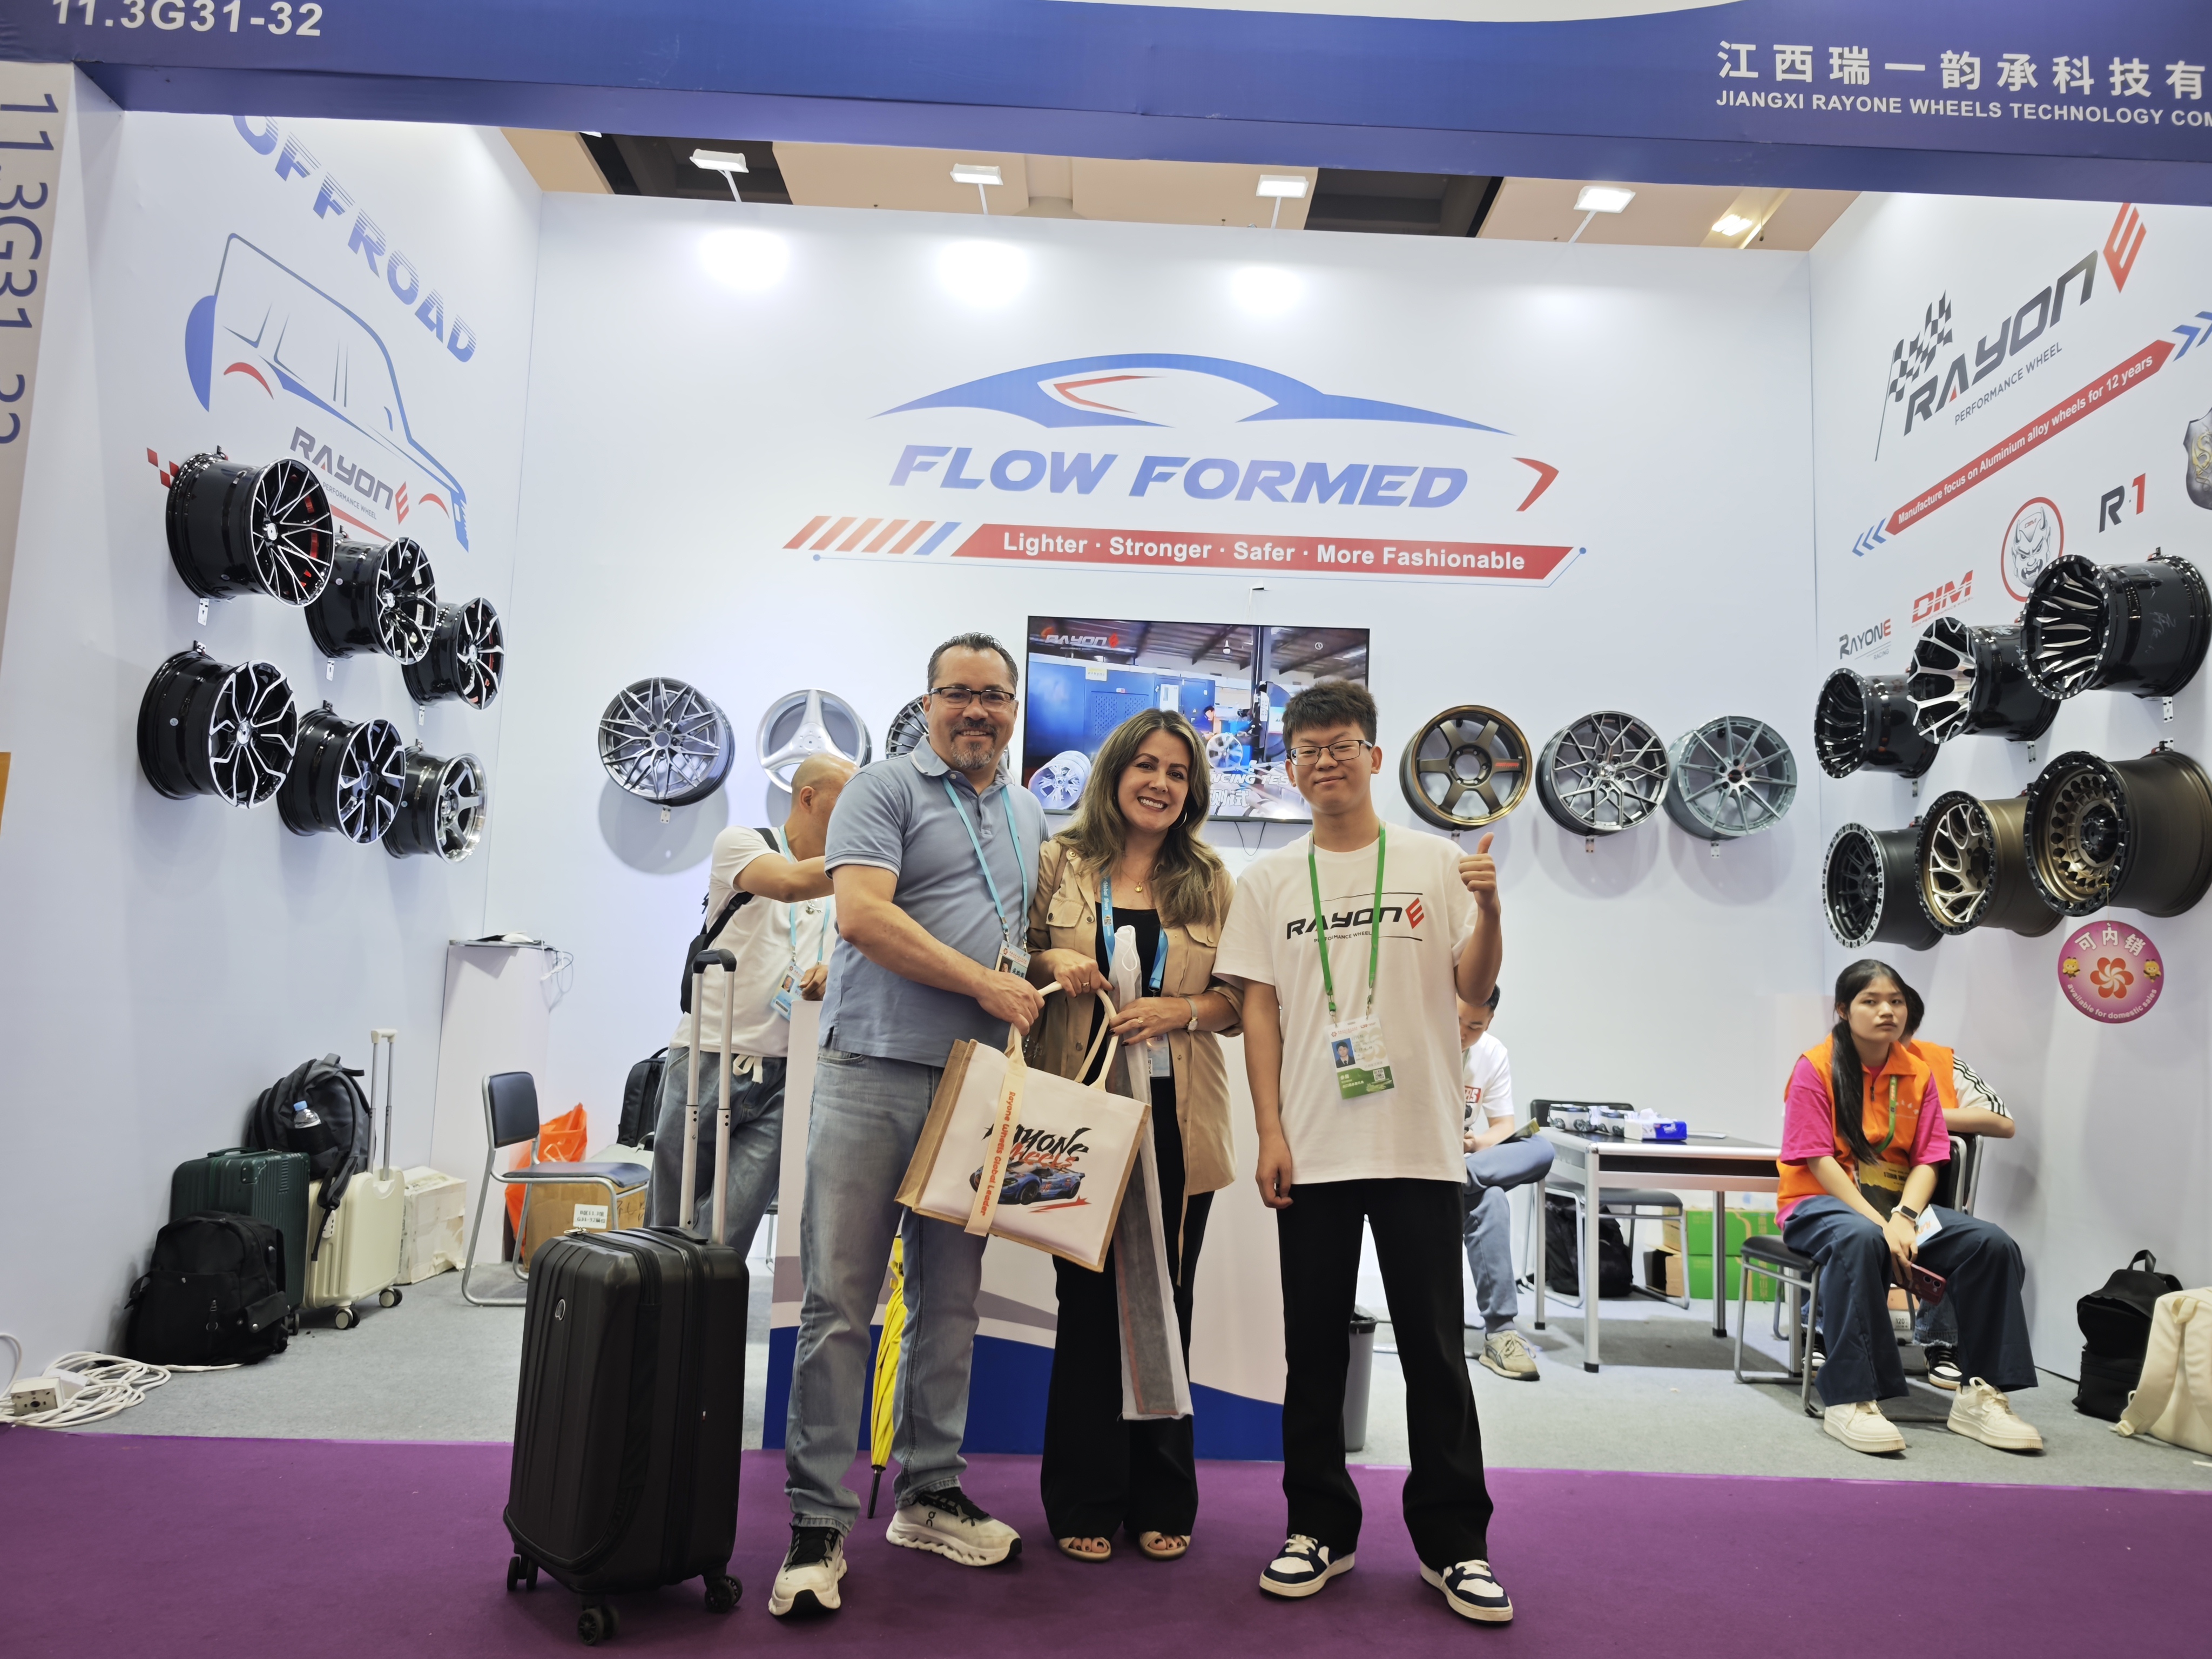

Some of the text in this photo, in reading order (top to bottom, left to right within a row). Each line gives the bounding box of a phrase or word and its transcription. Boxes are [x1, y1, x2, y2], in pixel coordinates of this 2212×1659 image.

[52, 0, 323, 36] 11.3G31-32
[1717, 40, 2206, 100] 江西瑞一韵承科技有
[1716, 91, 1804, 109] JIANGXI
[1812, 94, 1902, 113] RAYONE
[1910, 99, 2001, 118] WHEELS
[2012, 103, 2164, 125] TECHNOLOGY
[1904, 203, 2147, 436] RAYONE
[1955, 342, 2062, 426] PERFORMANCE WHEEL
[1898, 356, 2153, 524] Manufacture focus on Aluminium alloy wheels for 12 years
[290, 426, 409, 525] RAYONE
[888, 444, 1468, 508] FLOW FORMED
[323, 482, 377, 520] PERFORMANCE WHEEL
[1004, 532, 1525, 570] Lighter Stronger Safer More Fashionable
[1912, 570, 1973, 623] DIM
[1839, 618, 1891, 660] RAYONE
[1873, 649, 1889, 660] RACING
[2074, 922, 2146, 956] 可内销
[2067, 983, 2157, 1019] available for domestic sales
[981, 1091, 1016, 1216] Rayone Wheels Global Leader
